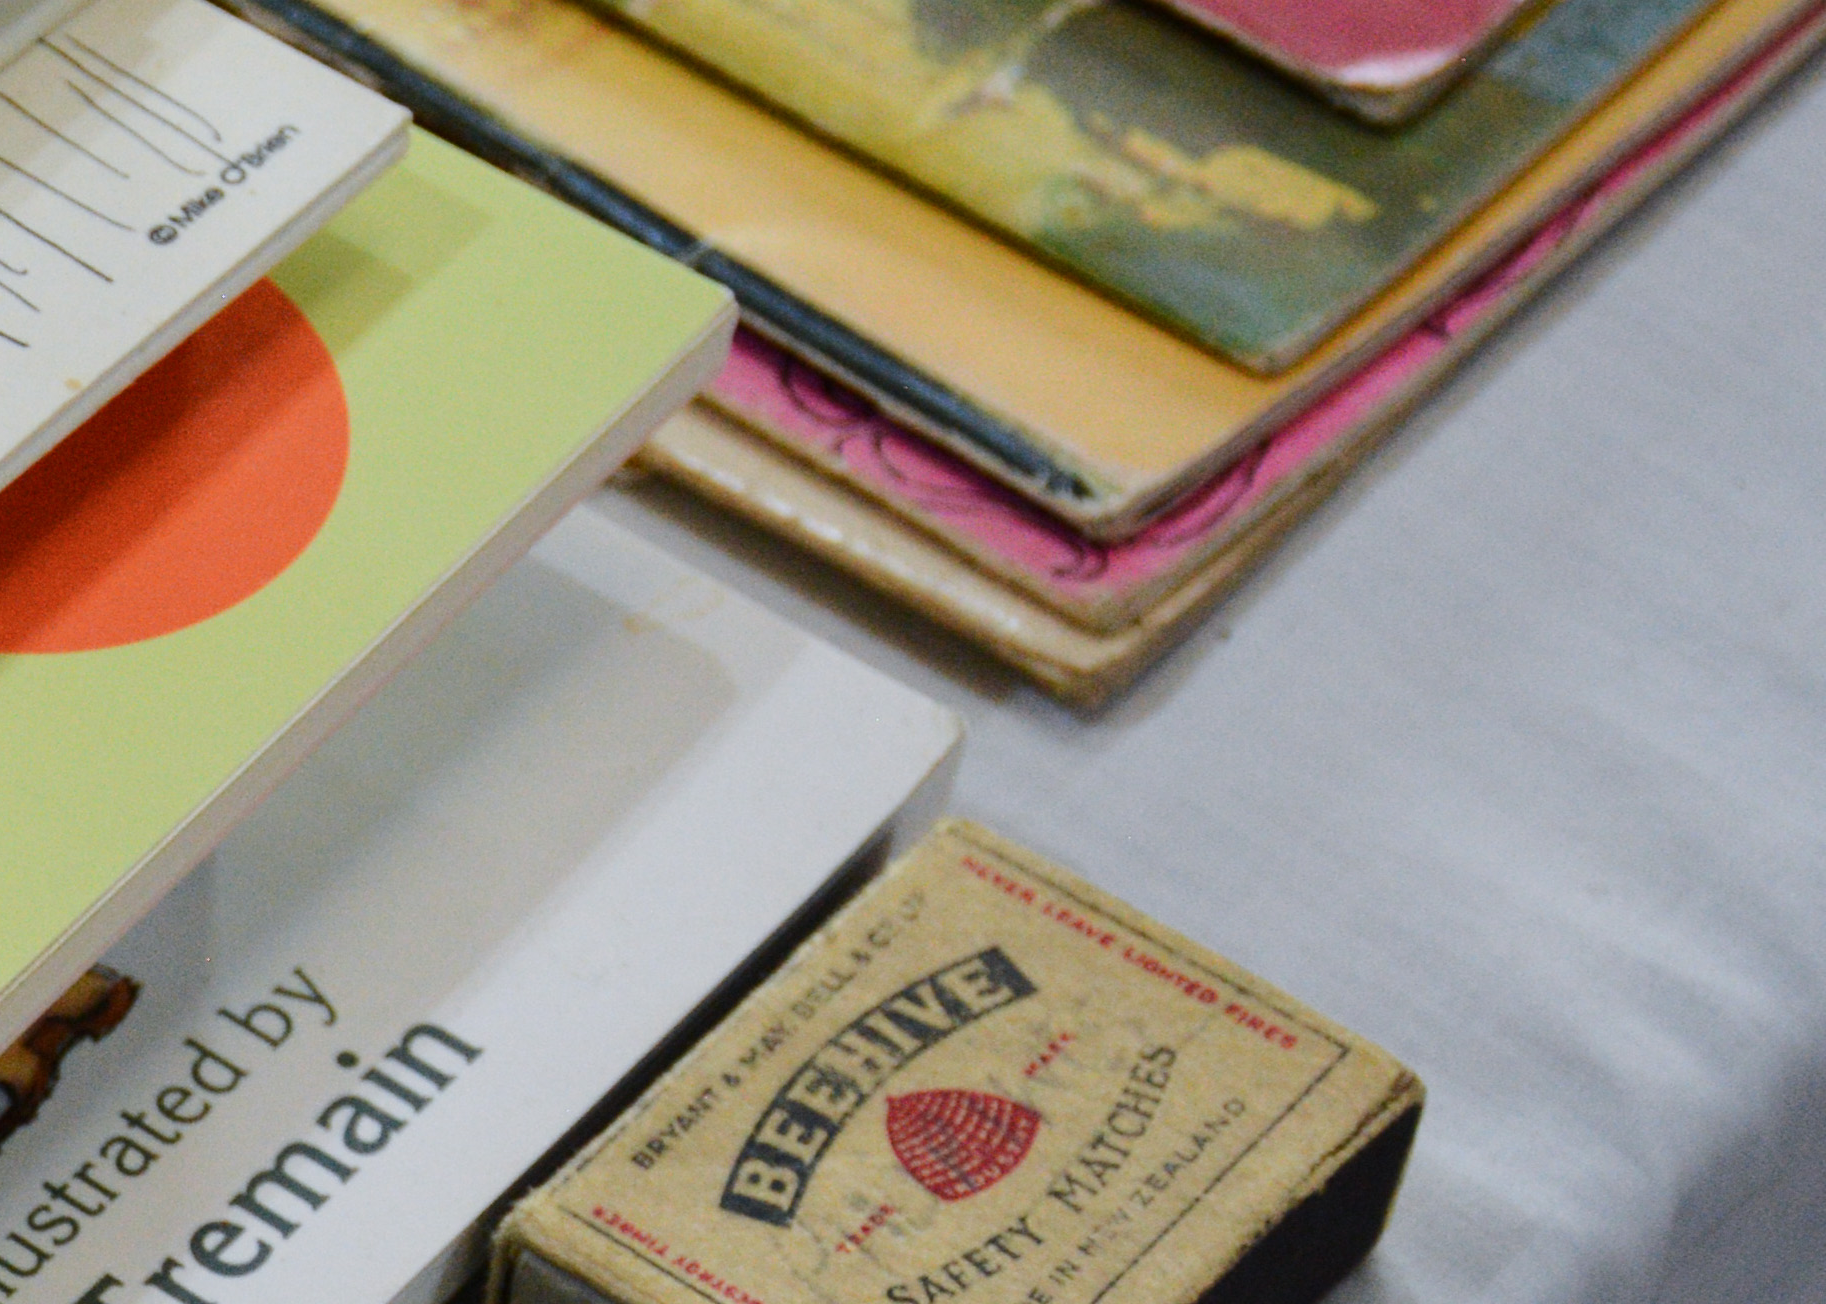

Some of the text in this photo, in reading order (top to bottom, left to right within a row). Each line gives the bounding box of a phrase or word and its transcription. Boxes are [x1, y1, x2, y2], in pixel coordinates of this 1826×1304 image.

[961, 853, 1299, 1051] NEVER LEAVE LIGHTED FIRES
[235, 964, 344, 1046] by
[726, 952, 1021, 1219] BEEHIVE
[1022, 1030, 1077, 1078] MARK
[630, 1087, 716, 1171] BRYANT
[1047, 1043, 1179, 1216] MATCHES
[591, 1204, 672, 1259] TIMBER
[834, 1203, 896, 1254] TRADE
[1049, 1257, 1081, 1287] IN
[1131, 1097, 1247, 1209] ZEALAND
